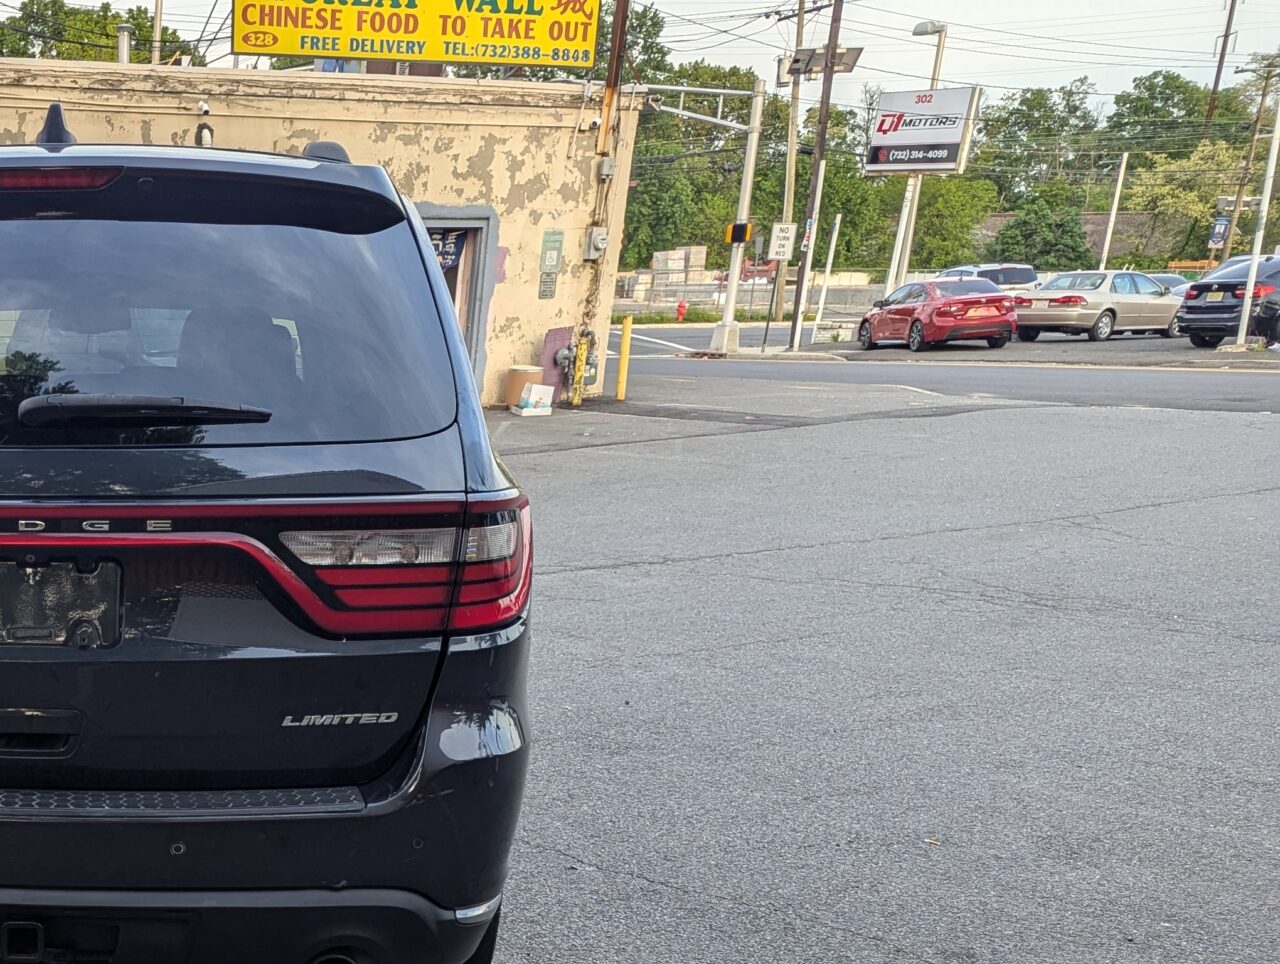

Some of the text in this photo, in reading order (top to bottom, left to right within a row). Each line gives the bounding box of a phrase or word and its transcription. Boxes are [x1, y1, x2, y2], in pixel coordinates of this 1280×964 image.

[241, 3, 592, 42] CHINESE FOOD TO TAKE OUT
[247, 33, 274, 45] 328
[300, 35, 340, 51] FREE
[349, 37, 426, 55] DELIVERY
[914, 94, 934, 104] 302
[901, 116, 959, 128] MOTORS
[889, 149, 948, 161] (732) 314-4099
[779, 226, 790, 234] NO
[281, 712, 399, 726] LIMITED
